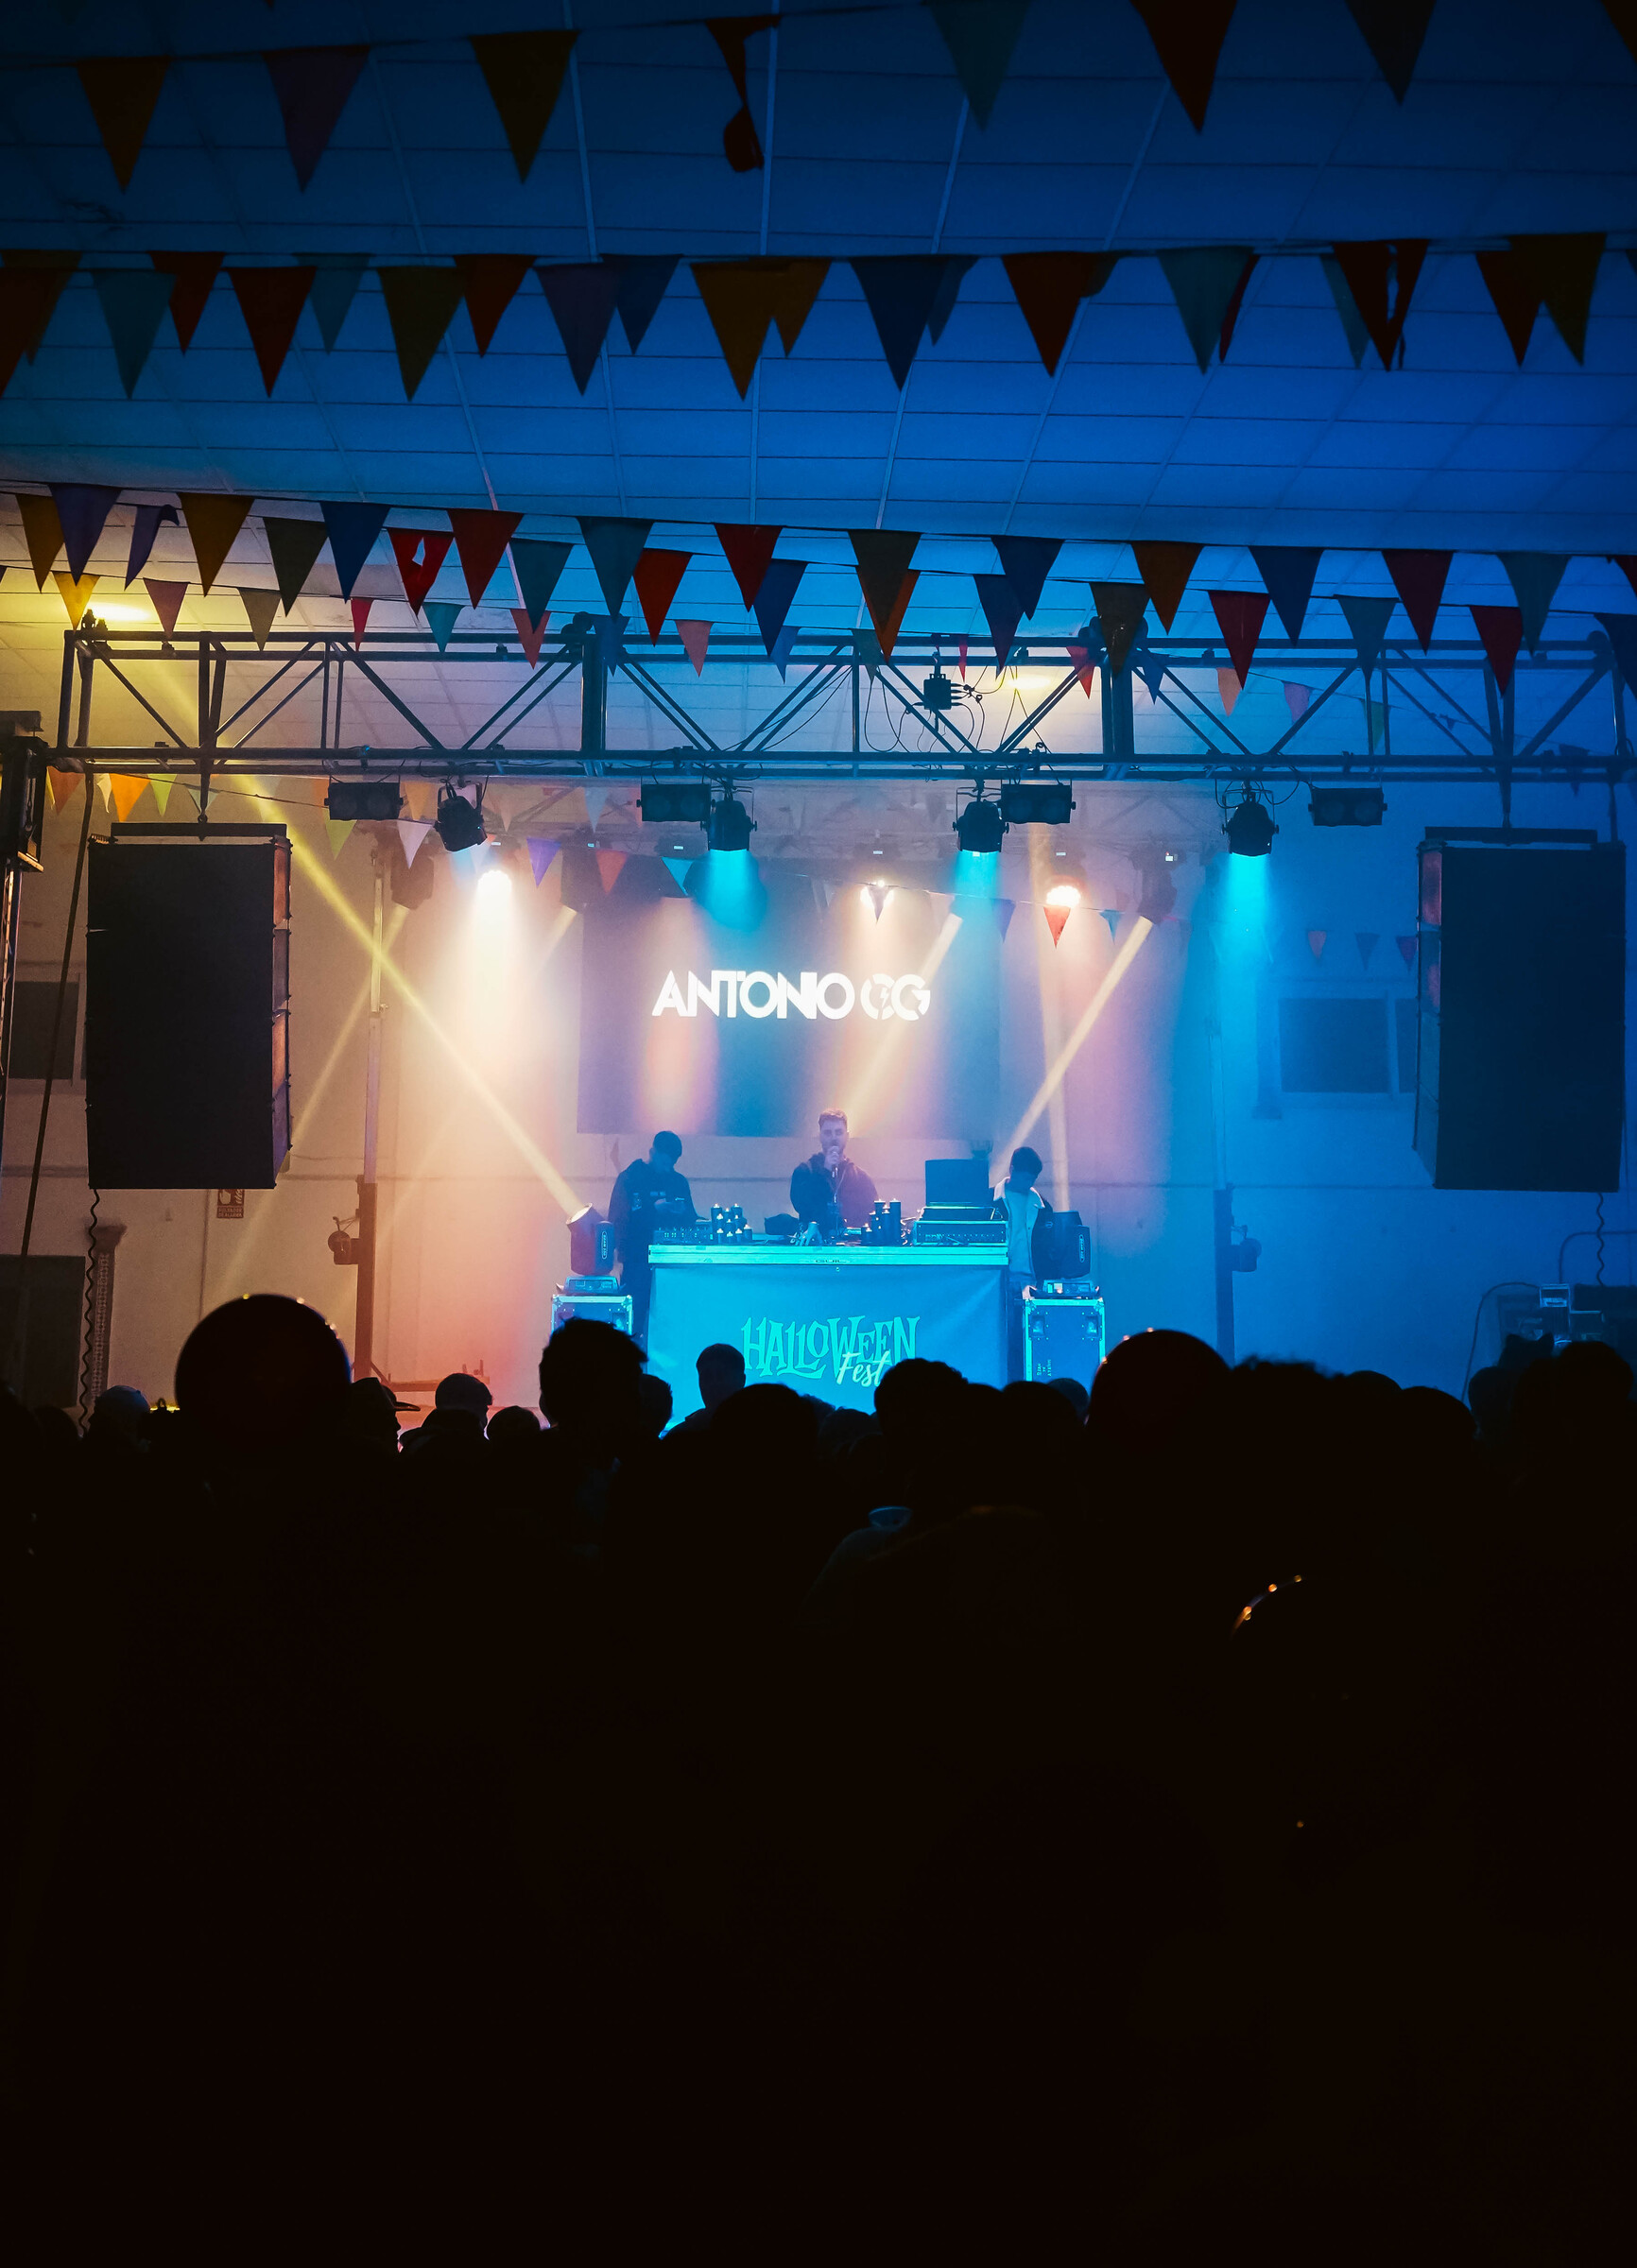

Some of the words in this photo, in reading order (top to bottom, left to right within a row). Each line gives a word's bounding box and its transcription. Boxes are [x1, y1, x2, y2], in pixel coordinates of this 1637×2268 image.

[652, 970, 855, 1020] ANTONIO
[741, 1315, 921, 1379] HALLOWEEN
[836, 1350, 890, 1387] Fest
